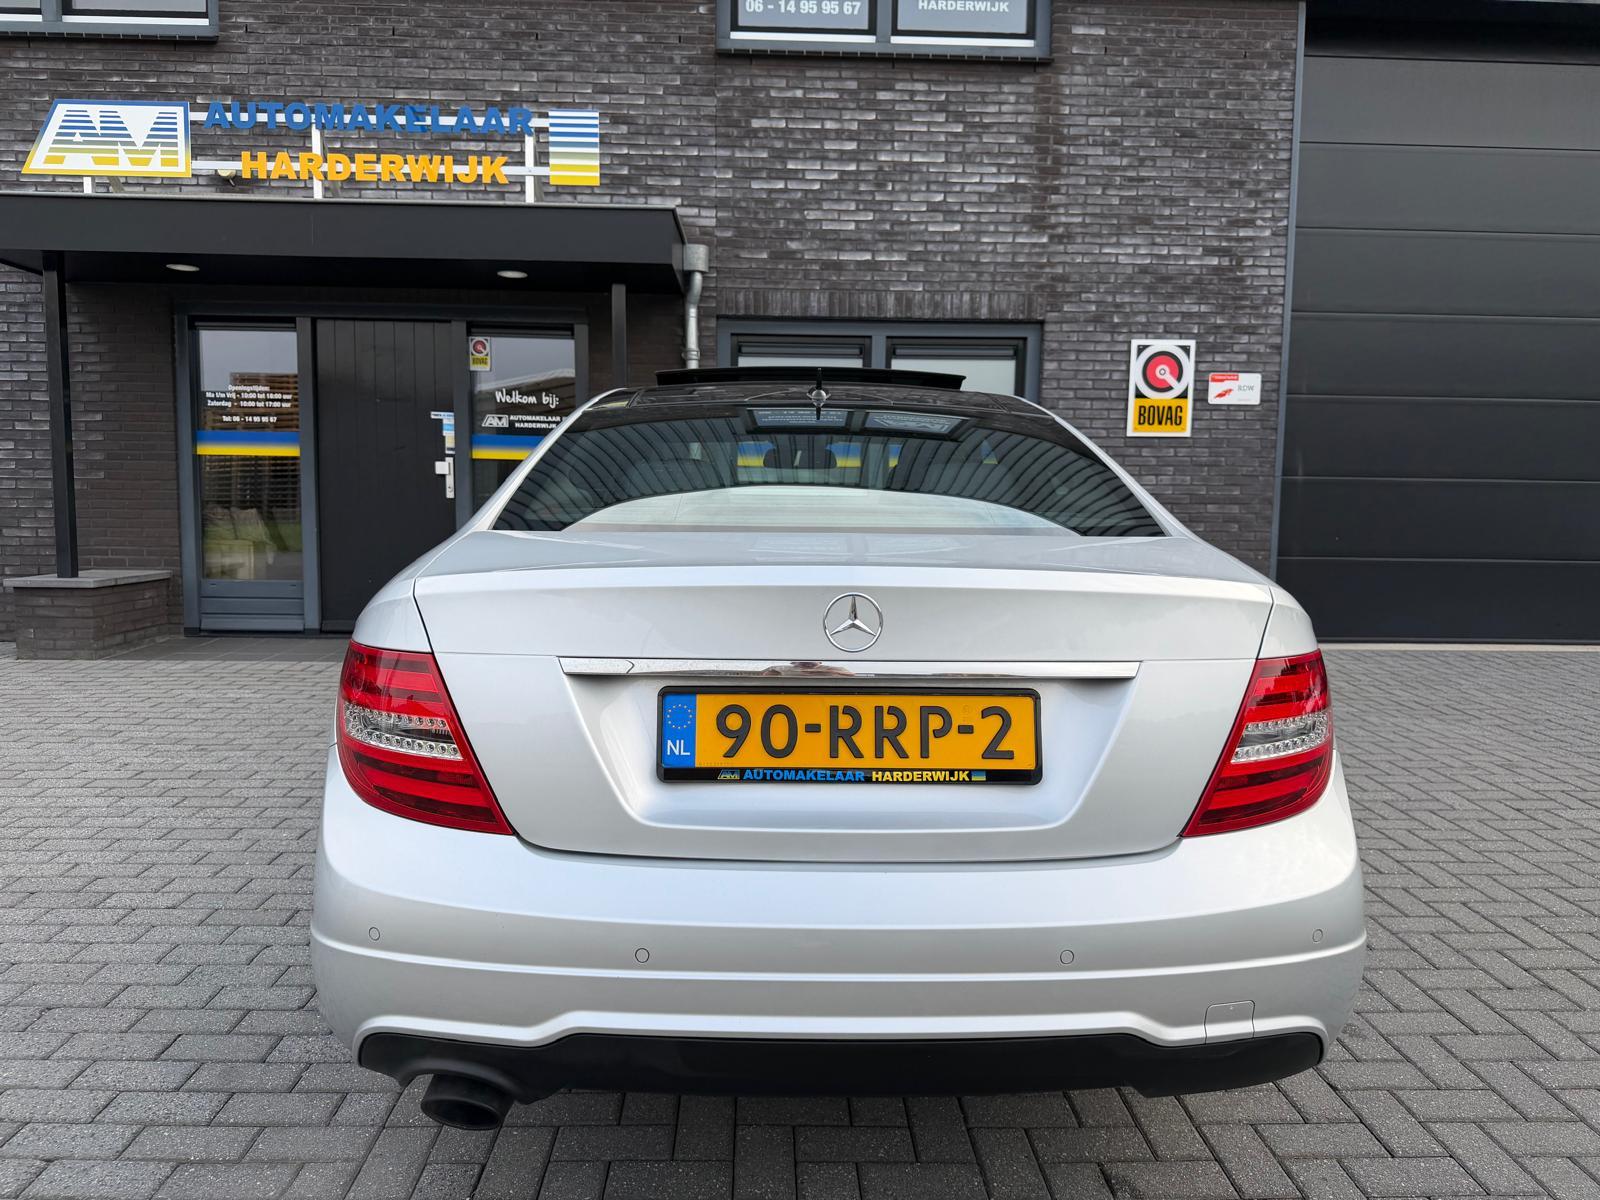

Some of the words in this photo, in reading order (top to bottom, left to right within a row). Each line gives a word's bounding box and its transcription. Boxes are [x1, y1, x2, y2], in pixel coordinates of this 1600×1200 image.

[745, 0, 764, 13] 06
[778, 0, 796, 14] 14
[800, 0, 818, 14] 95
[821, 0, 840, 15] 95
[843, 1, 861, 15] 67
[918, 0, 1010, 12] HARDERWIJK
[203, 102, 534, 134] AUTOMAKELAAR
[240, 150, 509, 184] HARDERWIJK
[495, 388, 537, 404] Welkom
[542, 391, 559, 408] bij:
[509, 414, 561, 422] AUTOMAKELAAR
[1138, 405, 1183, 426] BOVAG
[715, 704, 1014, 759] 90-RRP-2
[666, 739, 690, 756] NL
[743, 769, 865, 782] AUTOMAKELAAR
[872, 770, 970, 782] HARDERWIJK
